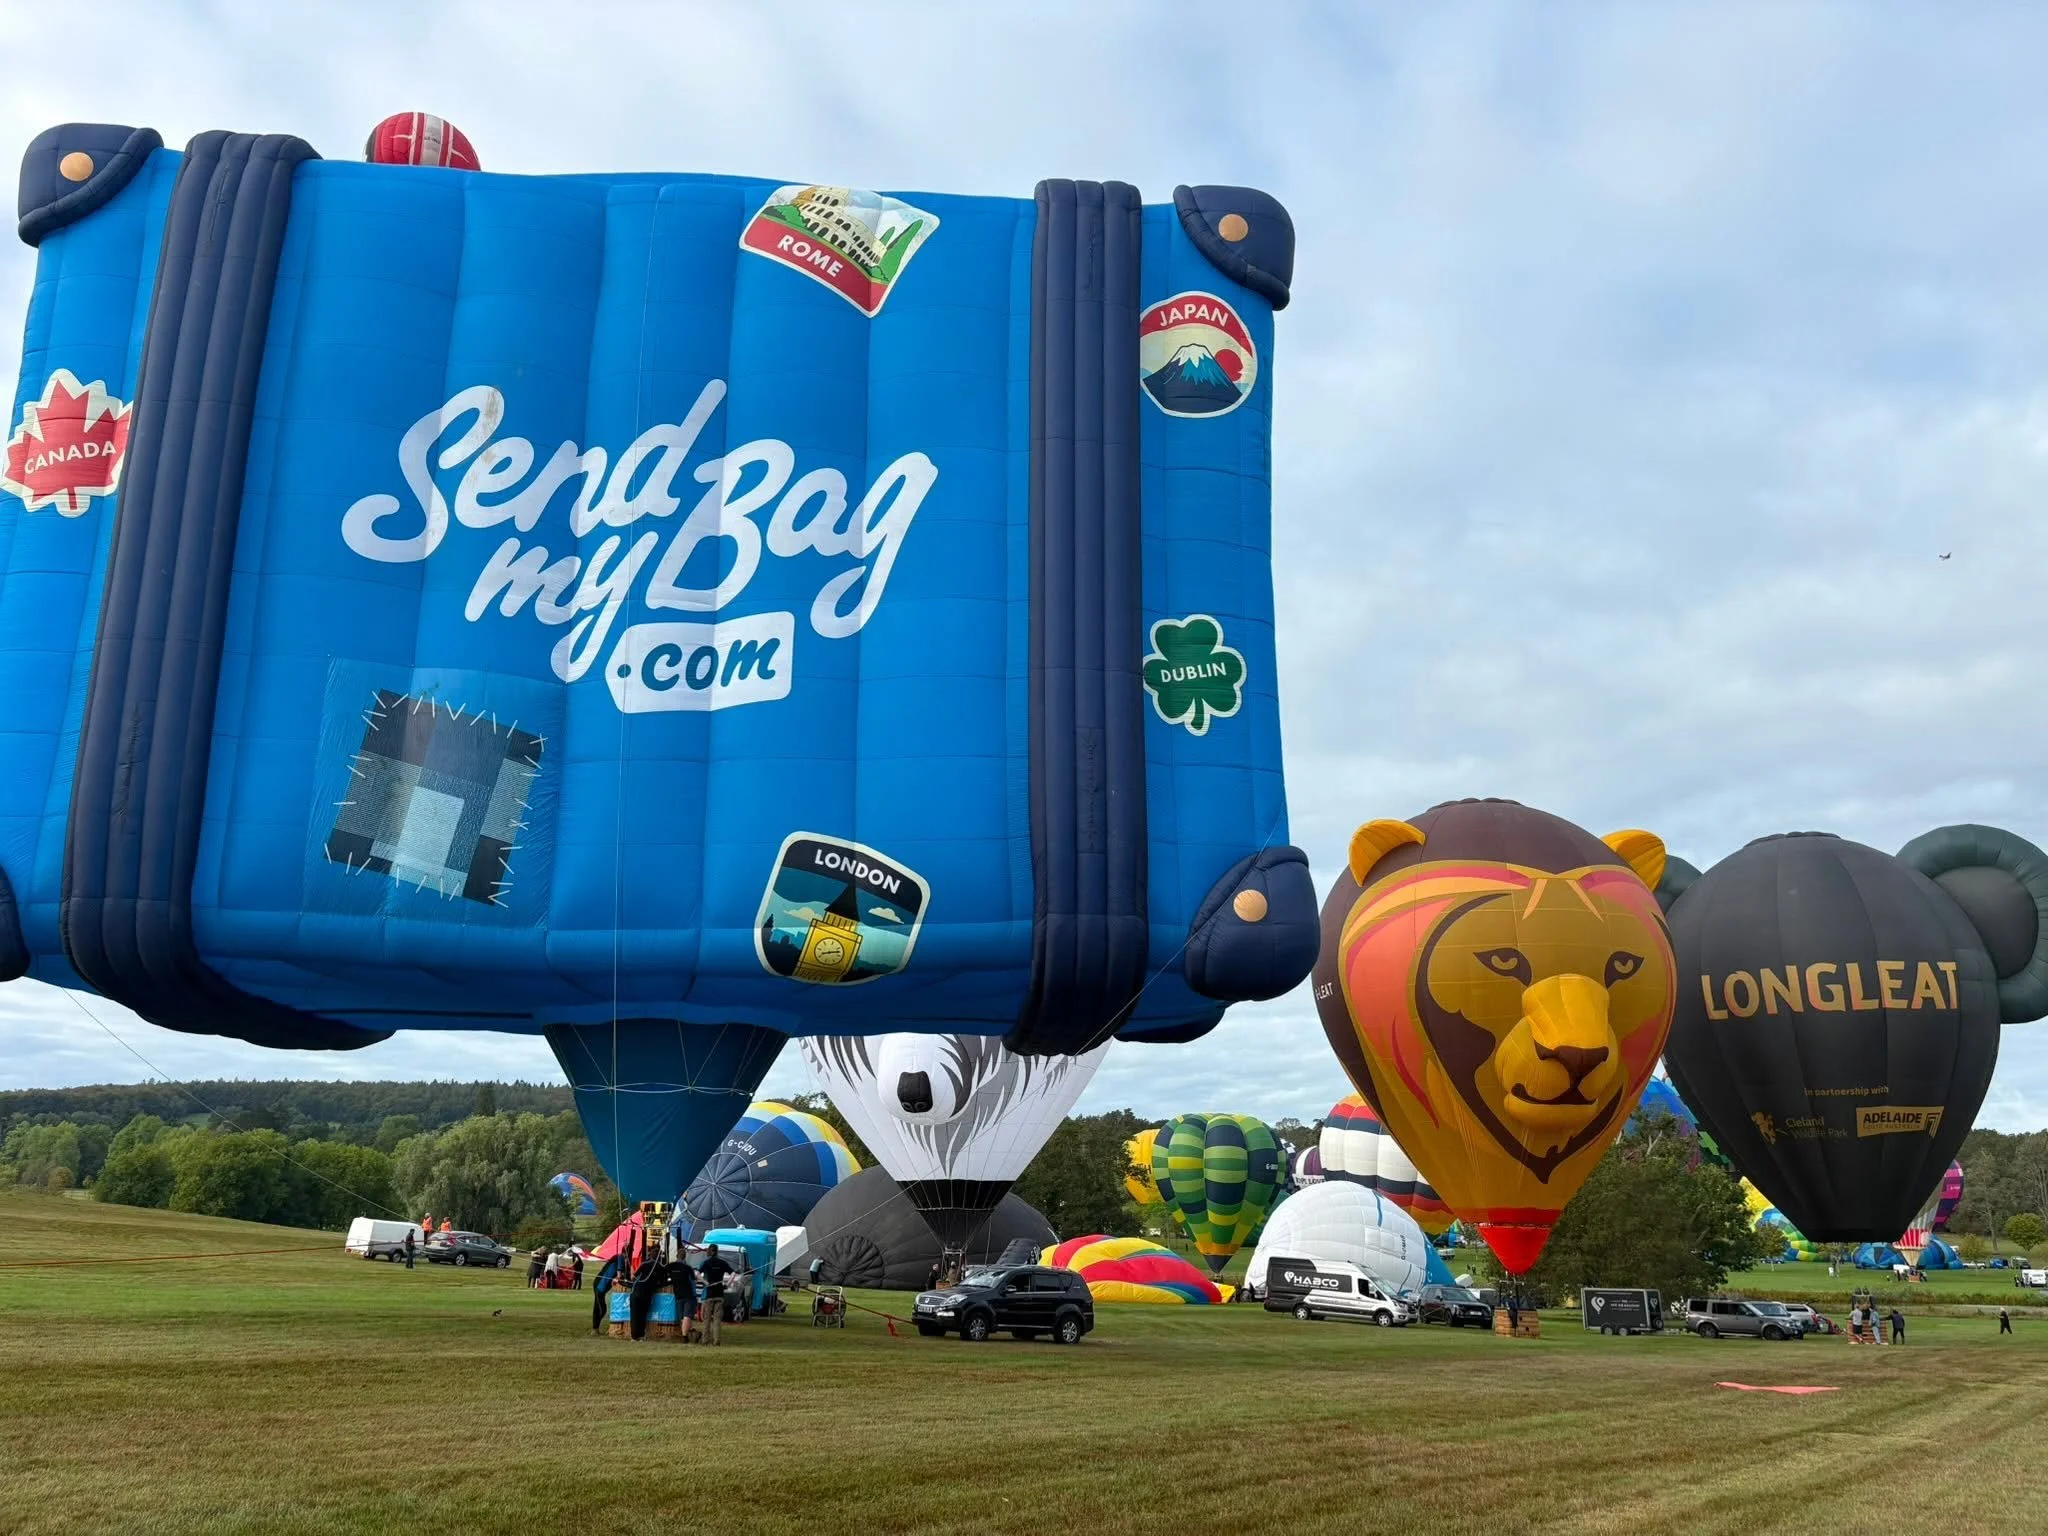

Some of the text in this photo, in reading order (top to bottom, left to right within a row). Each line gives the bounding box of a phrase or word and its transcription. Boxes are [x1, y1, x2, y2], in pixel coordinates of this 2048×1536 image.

[777, 234, 844, 278] ROME
[1159, 303, 1229, 327] JAPAN
[24, 440, 117, 474] CANADA
[341, 378, 728, 563] Send
[464, 438, 939, 683] my Bag
[616, 637, 781, 692] .com
[1160, 662, 1227, 683] DUBLIN
[814, 849, 901, 895] LONDON
[1701, 960, 1958, 1020] LONGLEAT
[1814, 1086, 1871, 1097] partnership
[1871, 1085, 1889, 1095] with
[1785, 1116, 1825, 1128] Cleland
[1862, 1111, 1922, 1124] ADELAIDE
[1828, 1127, 1849, 1138] Park
[1293, 1275, 1339, 1287] HABCO
